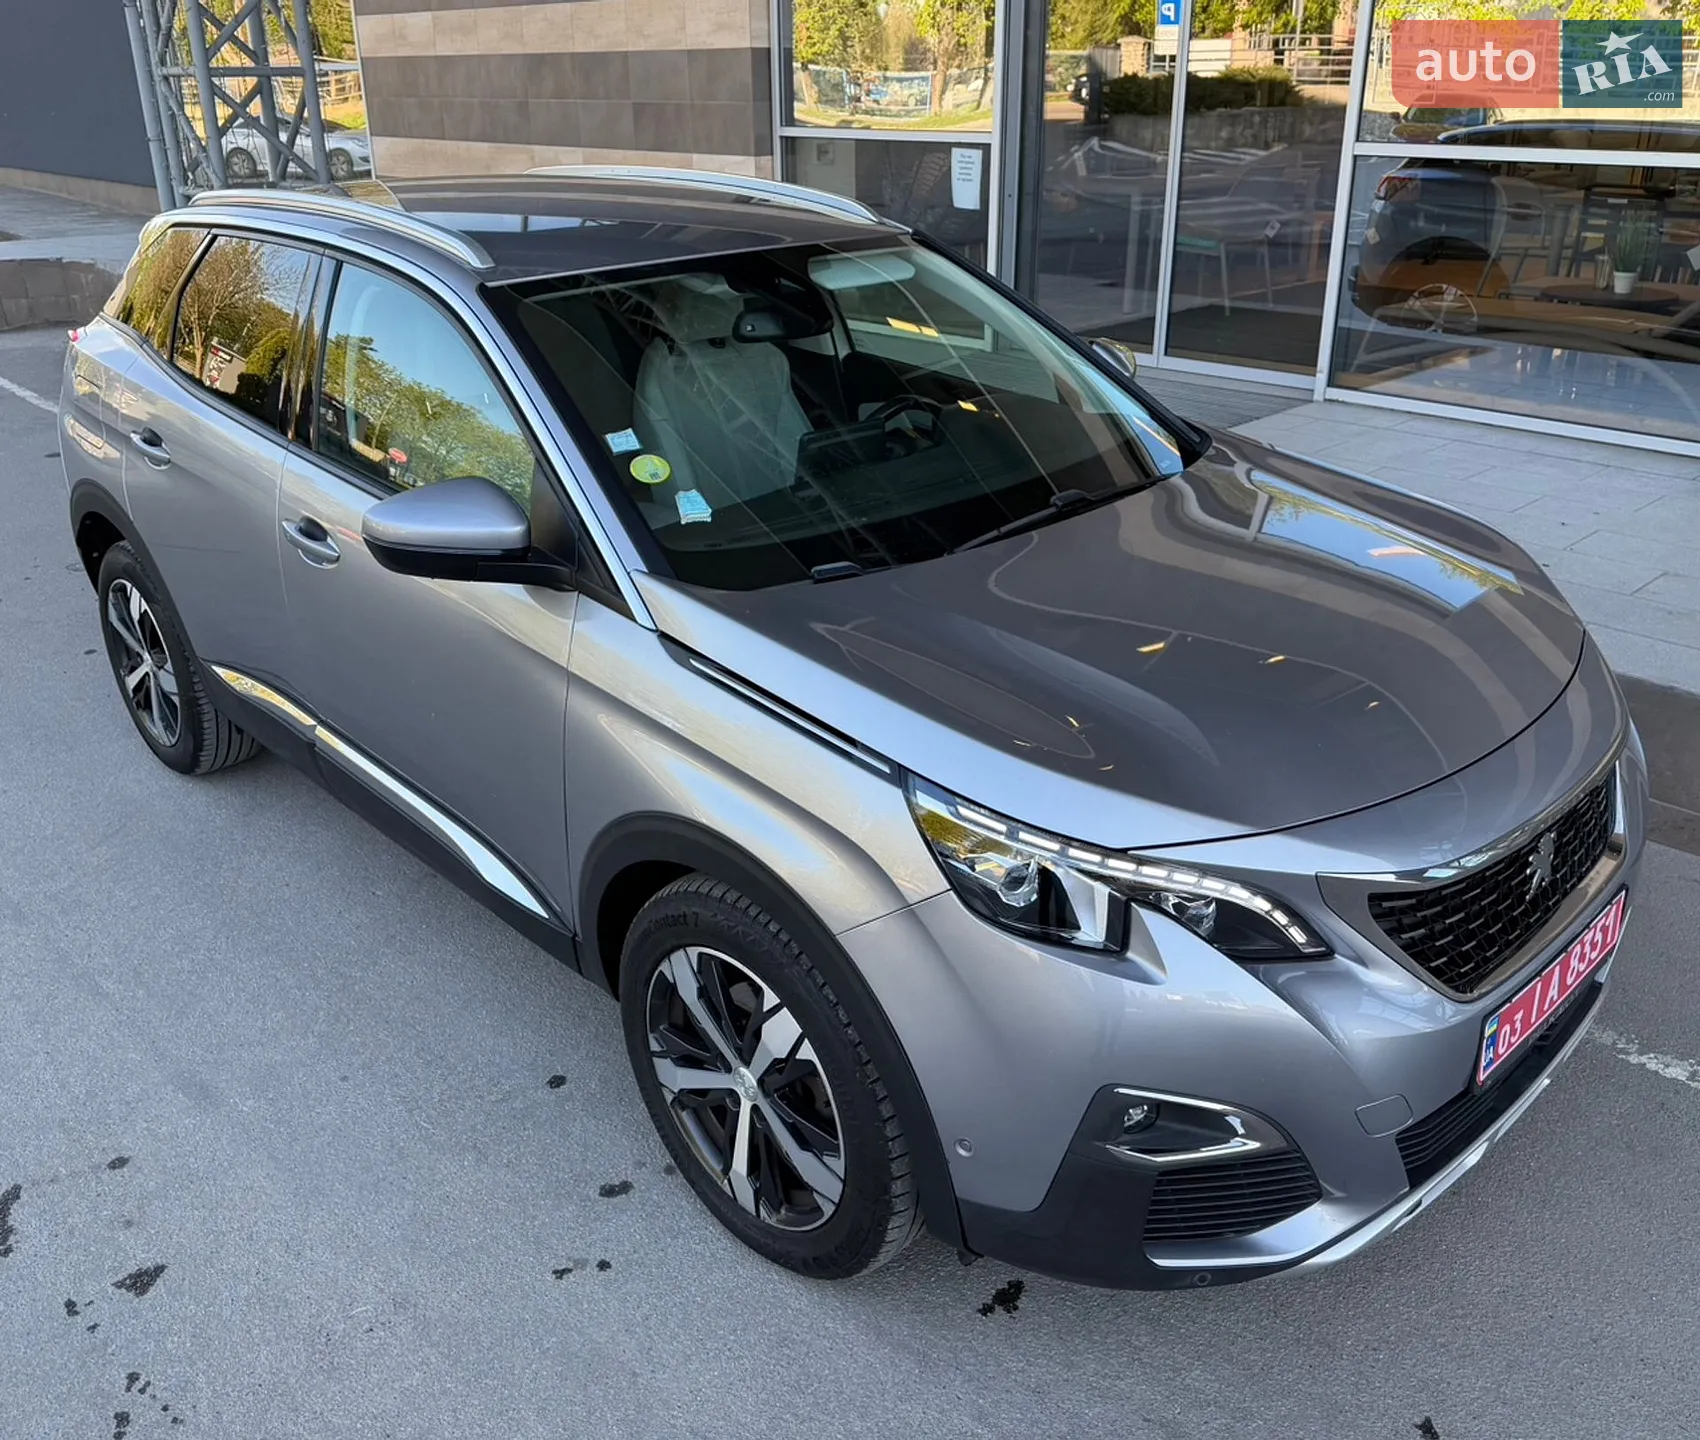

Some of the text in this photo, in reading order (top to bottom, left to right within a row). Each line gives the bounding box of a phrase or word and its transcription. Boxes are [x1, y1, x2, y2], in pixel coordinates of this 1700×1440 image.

[1497, 1009, 1524, 1055] 03
[1531, 965, 1560, 1024] IA
[1566, 904, 1618, 986] 8351
